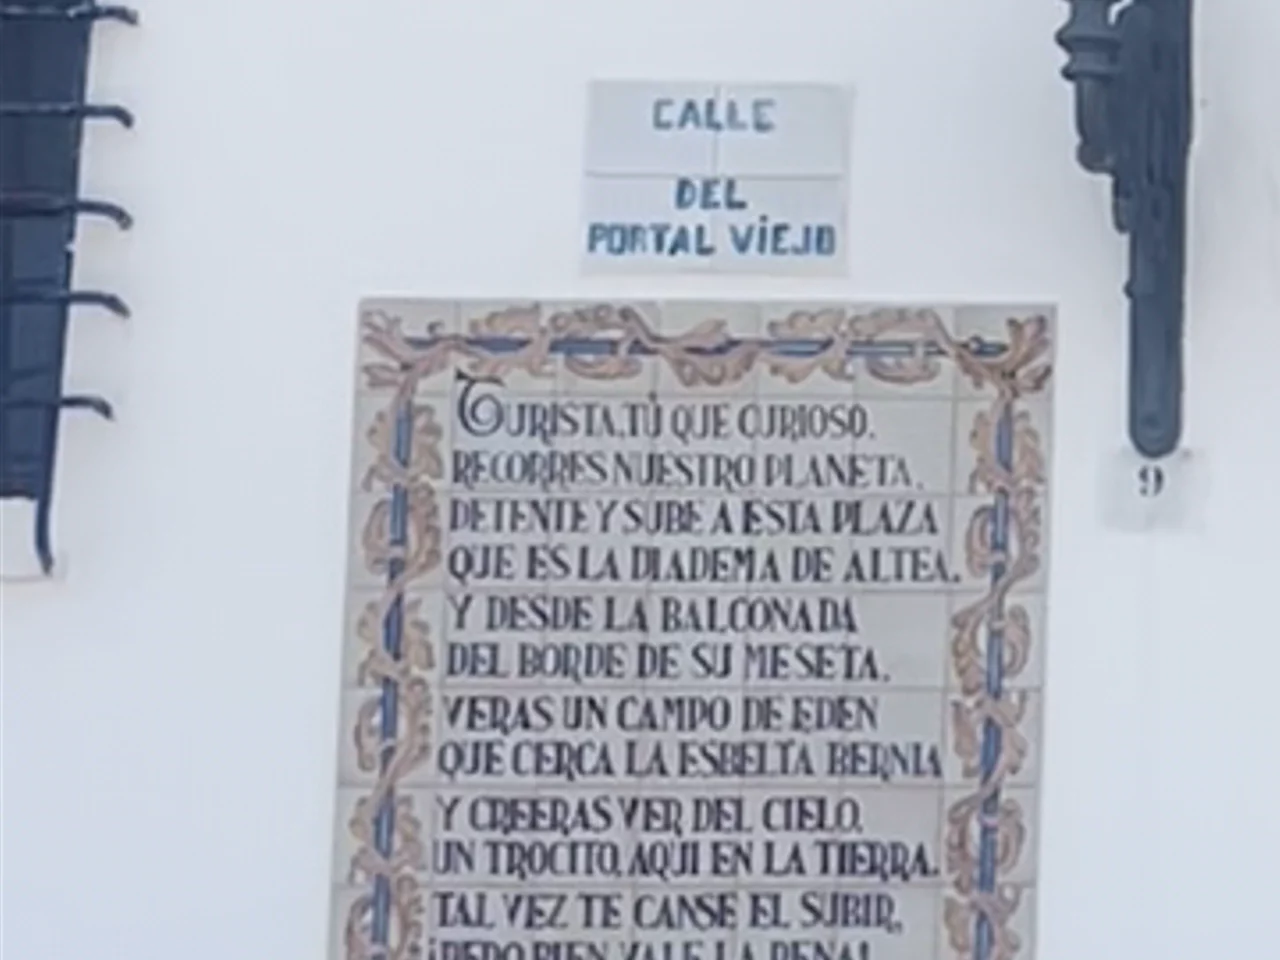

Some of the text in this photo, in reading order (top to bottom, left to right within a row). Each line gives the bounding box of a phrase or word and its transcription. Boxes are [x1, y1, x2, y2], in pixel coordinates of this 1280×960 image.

[652, 98, 776, 132] CALLE
[674, 176, 748, 210] DEL
[588, 222, 716, 256] PORTAL
[671, 402, 730, 446] QUE
[453, 450, 608, 492] RECORRES
[613, 452, 756, 493] NUESTRO
[1138, 464, 1165, 497] 9
[450, 499, 939, 537] DETENTE Y SUBE A ESTA PLAZA
[448, 545, 961, 587] QUE ES LA DIADEMA DE ALTEA.
[449, 594, 859, 634] Y DESDE LA BALCONADA
[447, 642, 511, 678] DEL
[517, 642, 625, 685] BORDE
[636, 643, 682, 679] DE
[691, 643, 732, 680] SU
[442, 695, 878, 736] VERAS UN CAMPO DE EDEN
[437, 738, 943, 783] QUE CERCA LA ESBELTA BERNIA
[436, 794, 462, 832] Y
[468, 795, 613, 837] CREERAS
[617, 796, 683, 838] VER
[691, 796, 752, 833] DEL
[433, 840, 475, 875] UN
[628, 840, 701, 883] AQUI
[710, 841, 753, 877] EN
[763, 841, 806, 877] LA
[431, 891, 495, 928] TAL
[502, 892, 568, 929] VEZ
[577, 891, 623, 928] TE
[633, 892, 739, 930] CANSE
[748, 892, 791, 929] EL
